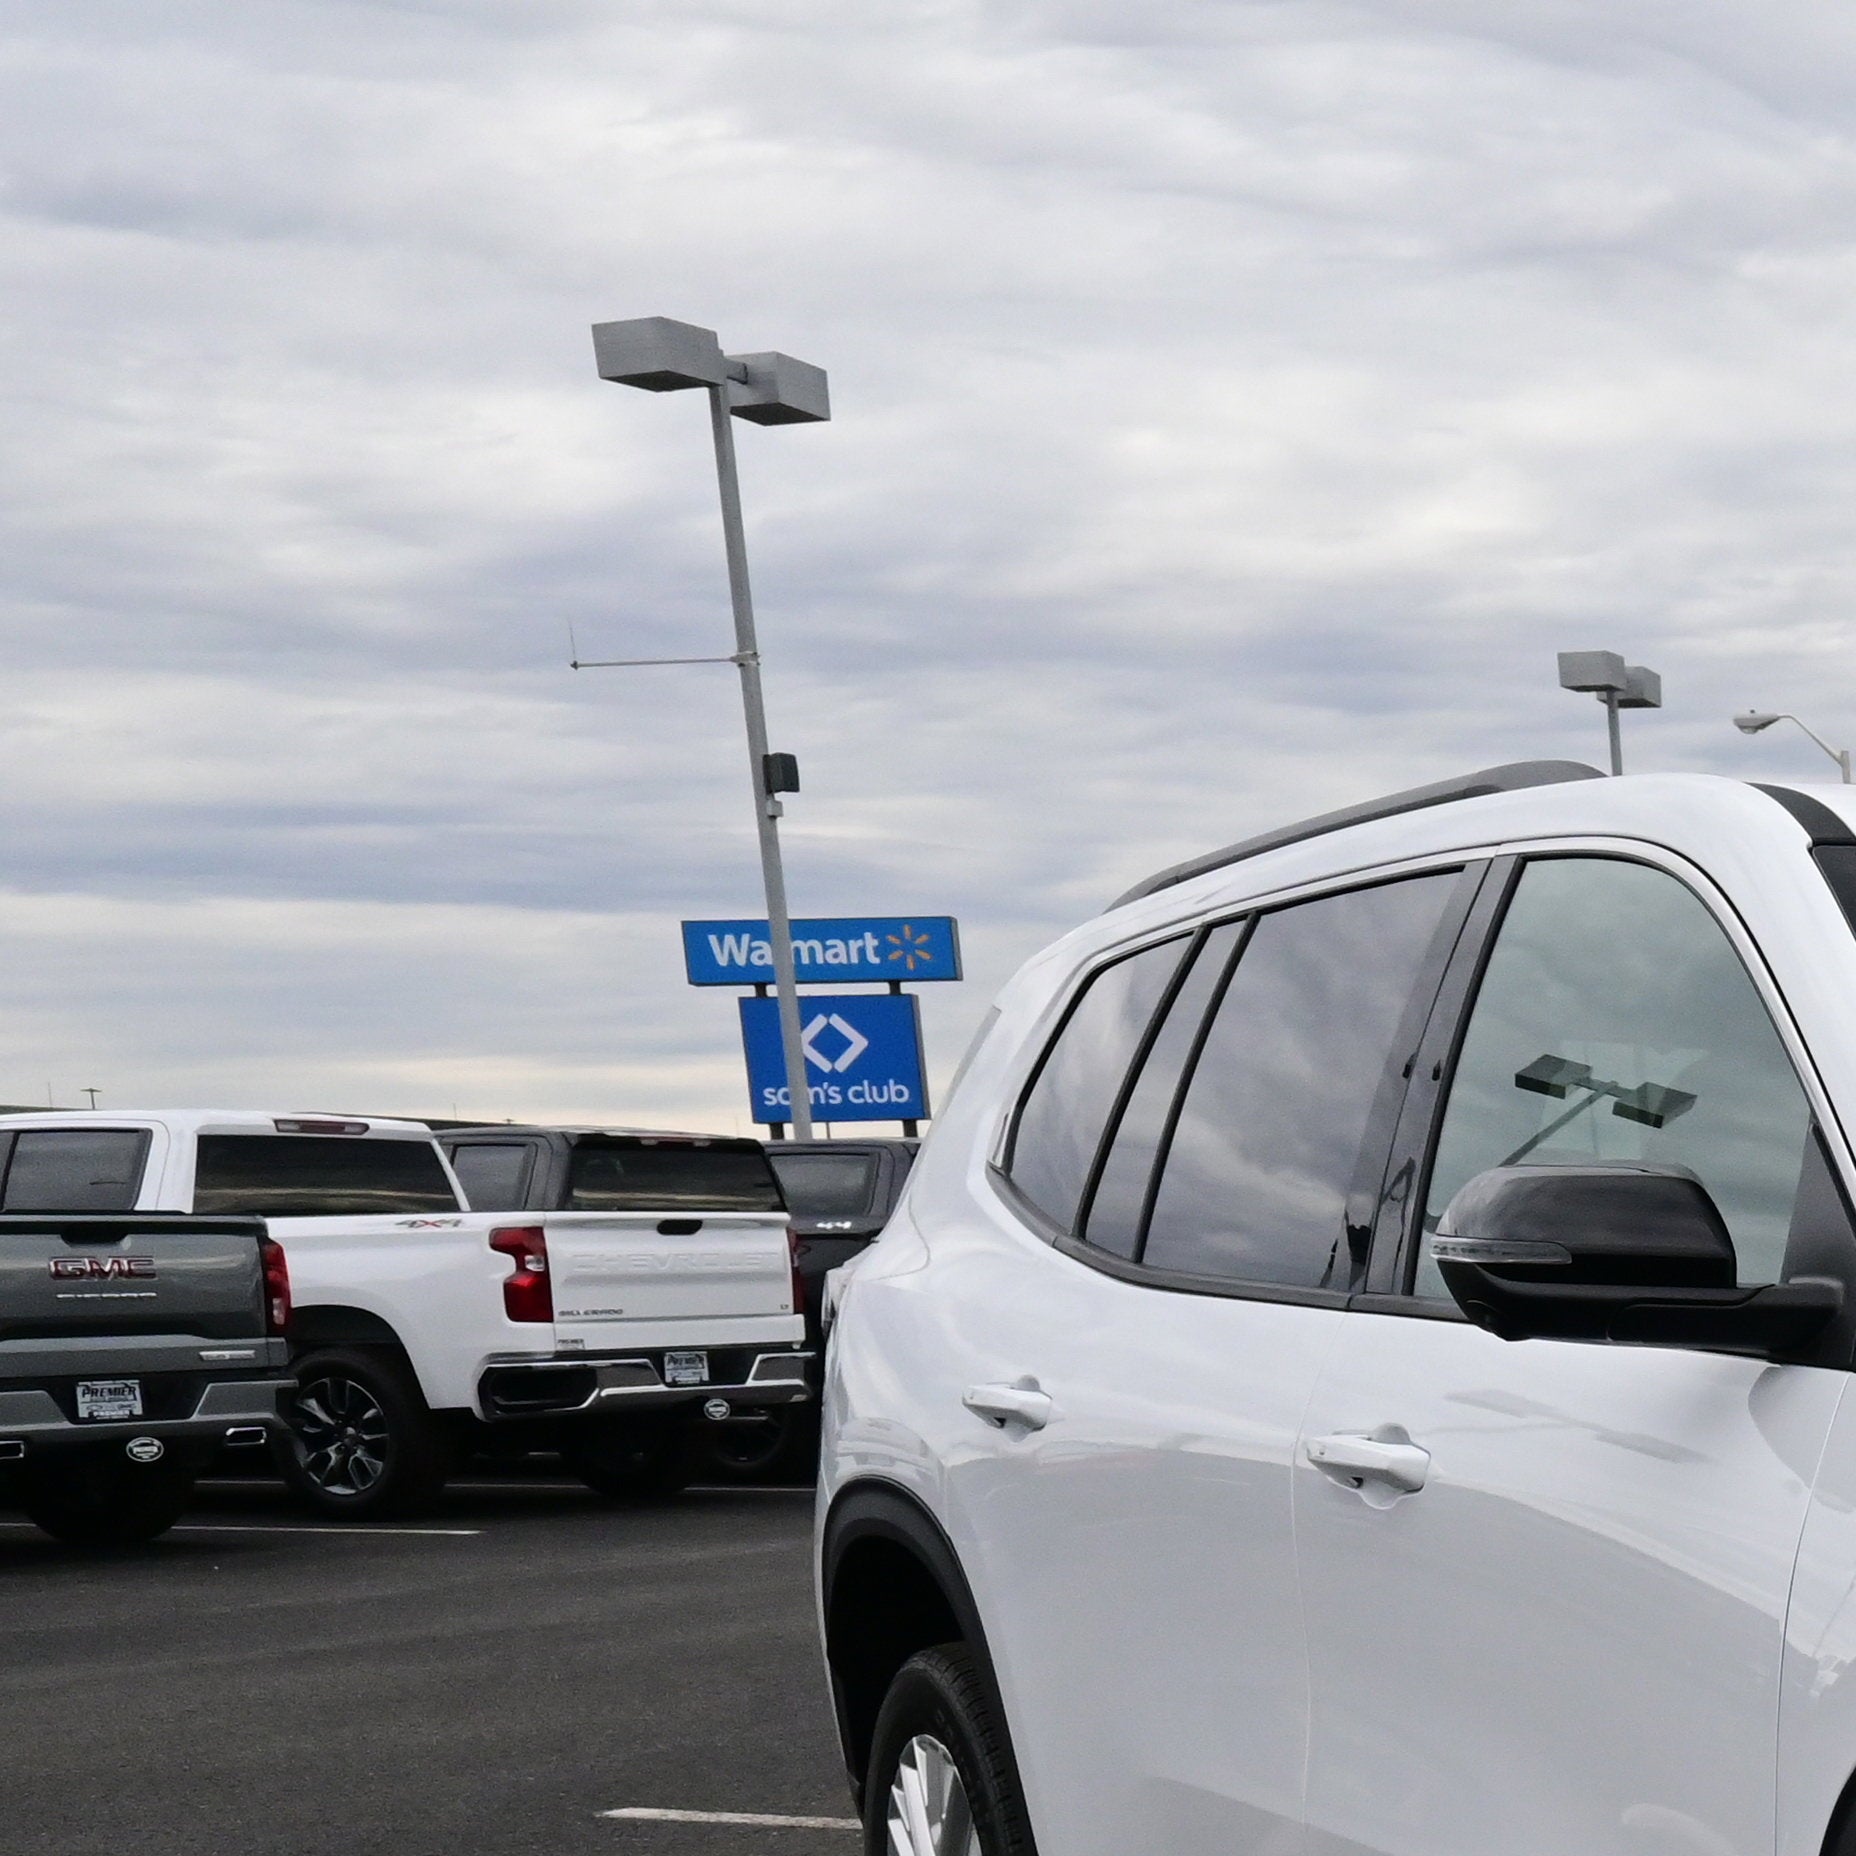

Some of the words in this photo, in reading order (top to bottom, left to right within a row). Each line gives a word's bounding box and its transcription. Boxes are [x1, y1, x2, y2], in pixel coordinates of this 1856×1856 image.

[708, 932, 880, 967] Wamart
[847, 1079, 910, 1103] club
[50, 1256, 157, 1281] GMC
[81, 1385, 138, 1400] PREMIER
